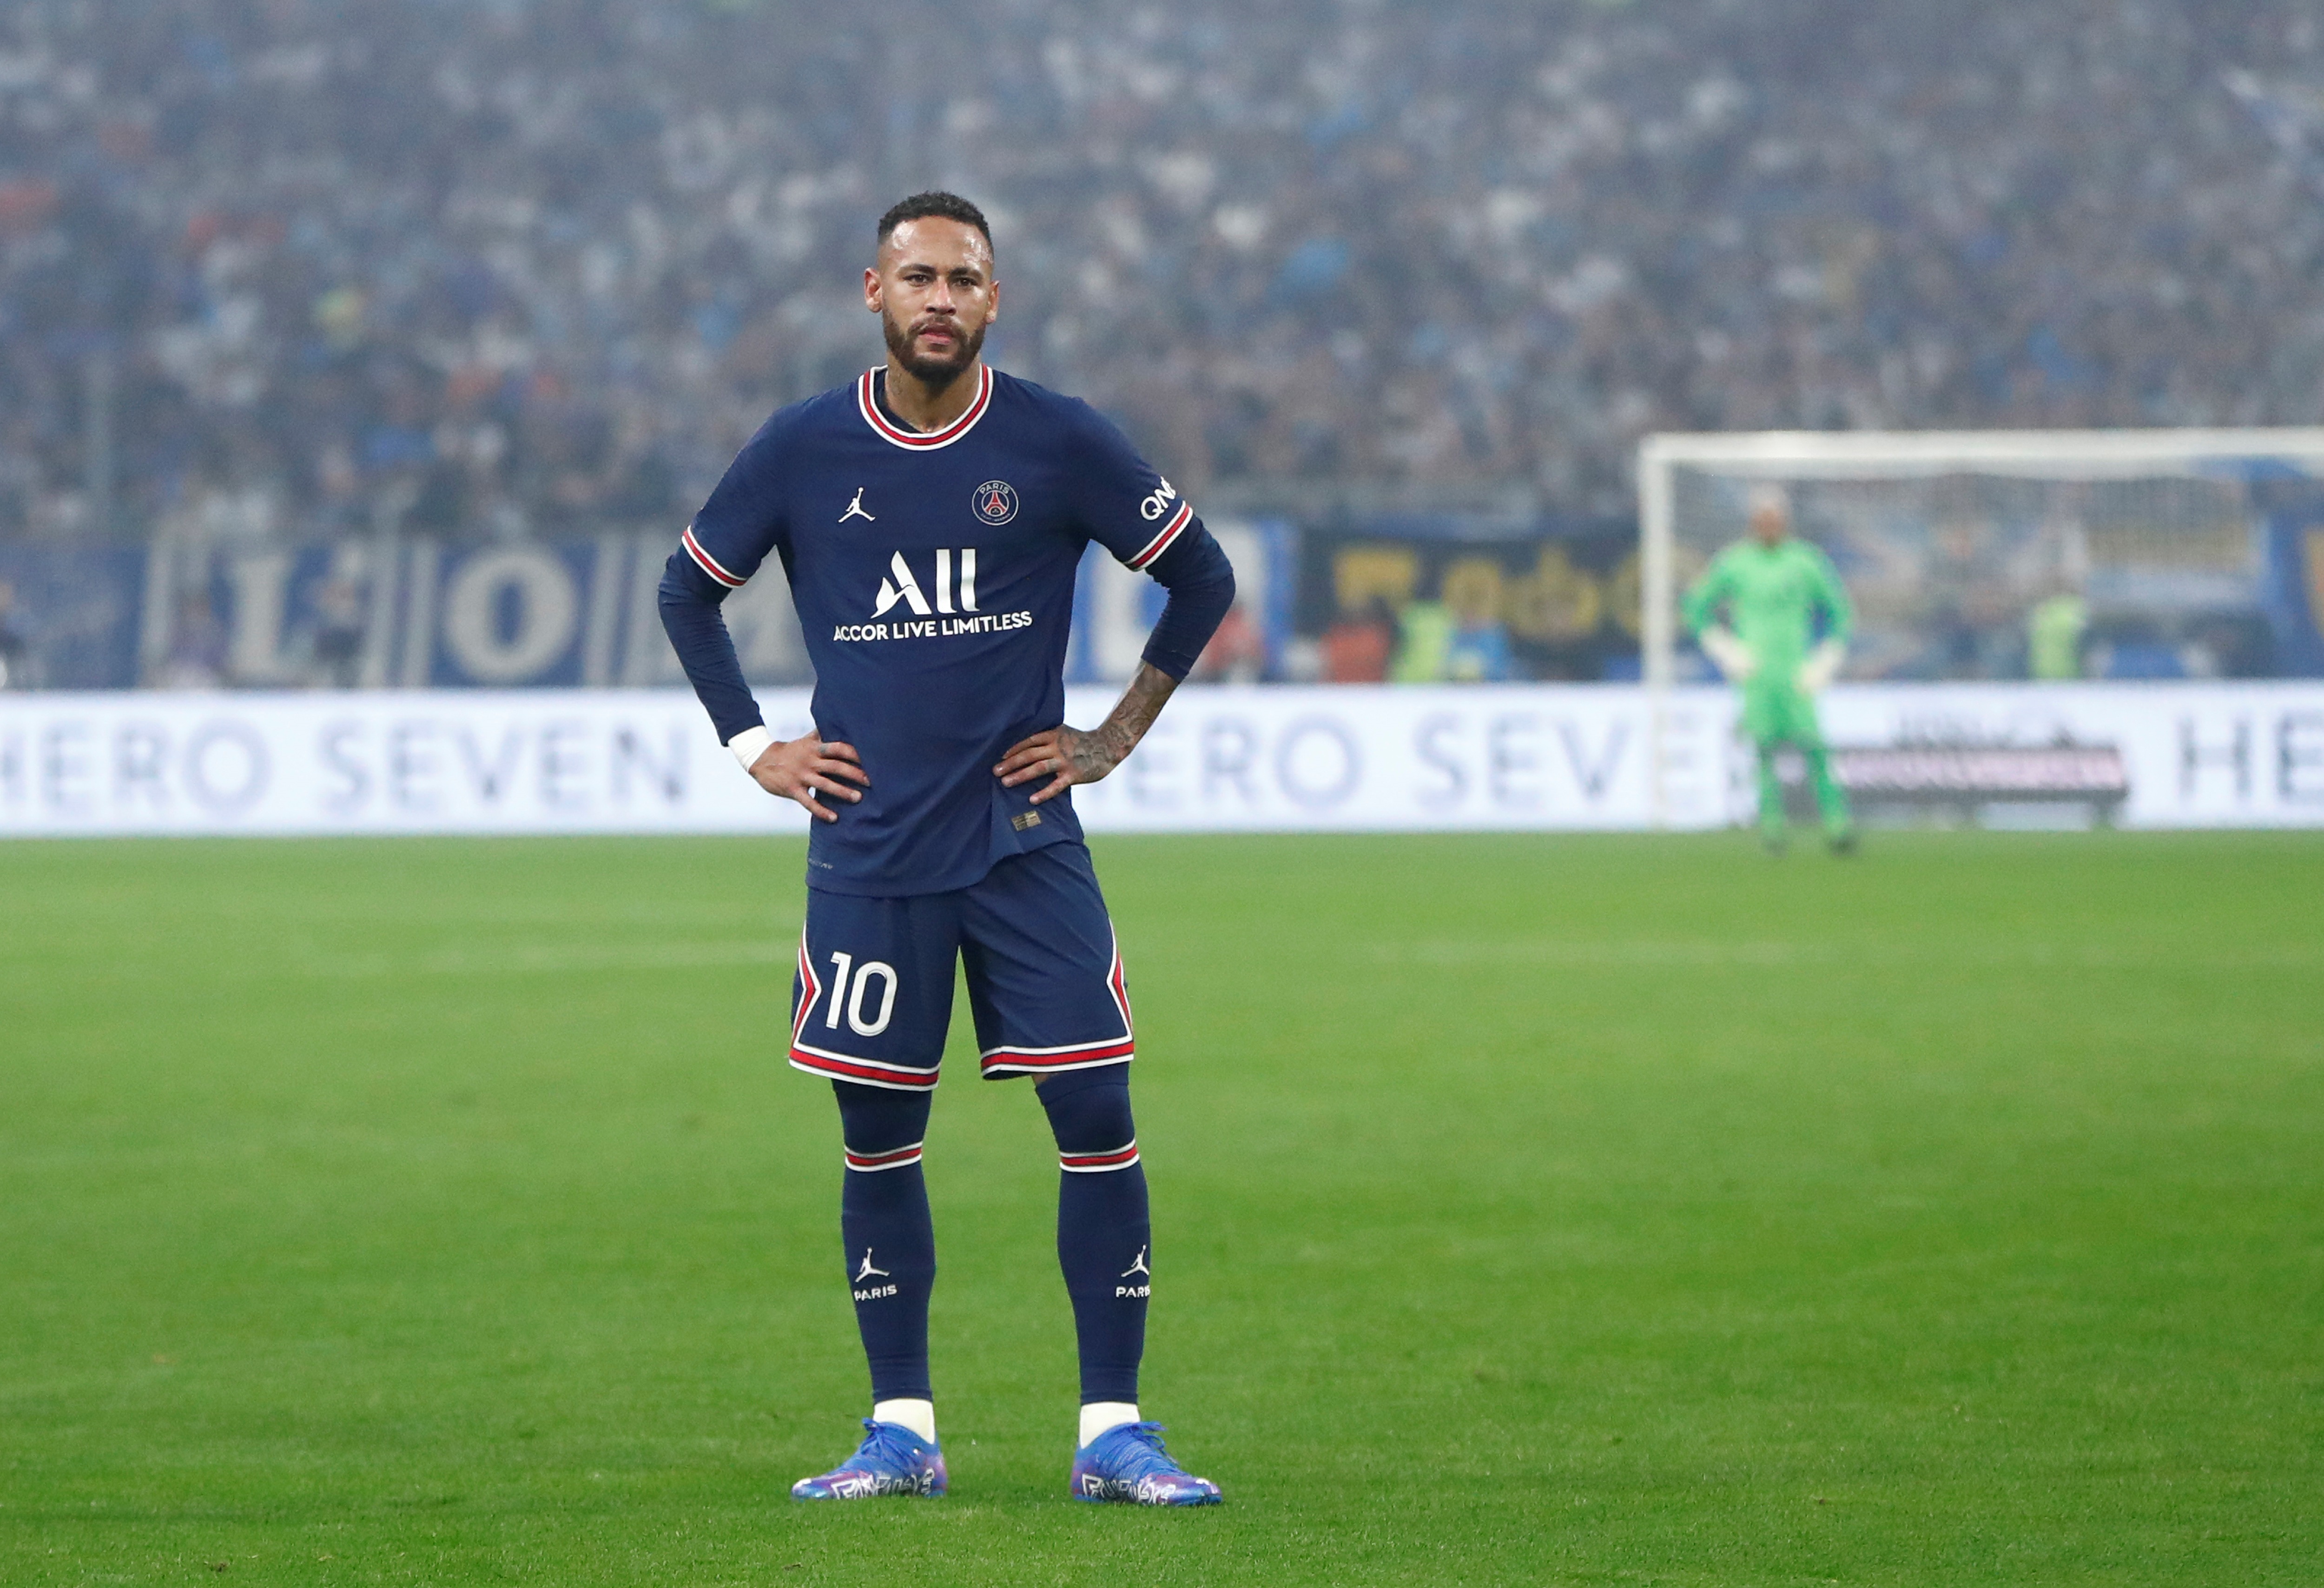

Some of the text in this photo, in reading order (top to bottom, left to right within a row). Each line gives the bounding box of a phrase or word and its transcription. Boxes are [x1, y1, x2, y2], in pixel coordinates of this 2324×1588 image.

[979, 483, 1010, 494] PARIS
[1140, 476, 1176, 521] QN
[833, 611, 1033, 641] ACCOR LIVE LIMITLESS
[316, 718, 692, 816] SEVEN
[1085, 713, 1367, 812] ERO
[825, 951, 898, 1037] 10
[853, 1284, 898, 1301] PARIS
